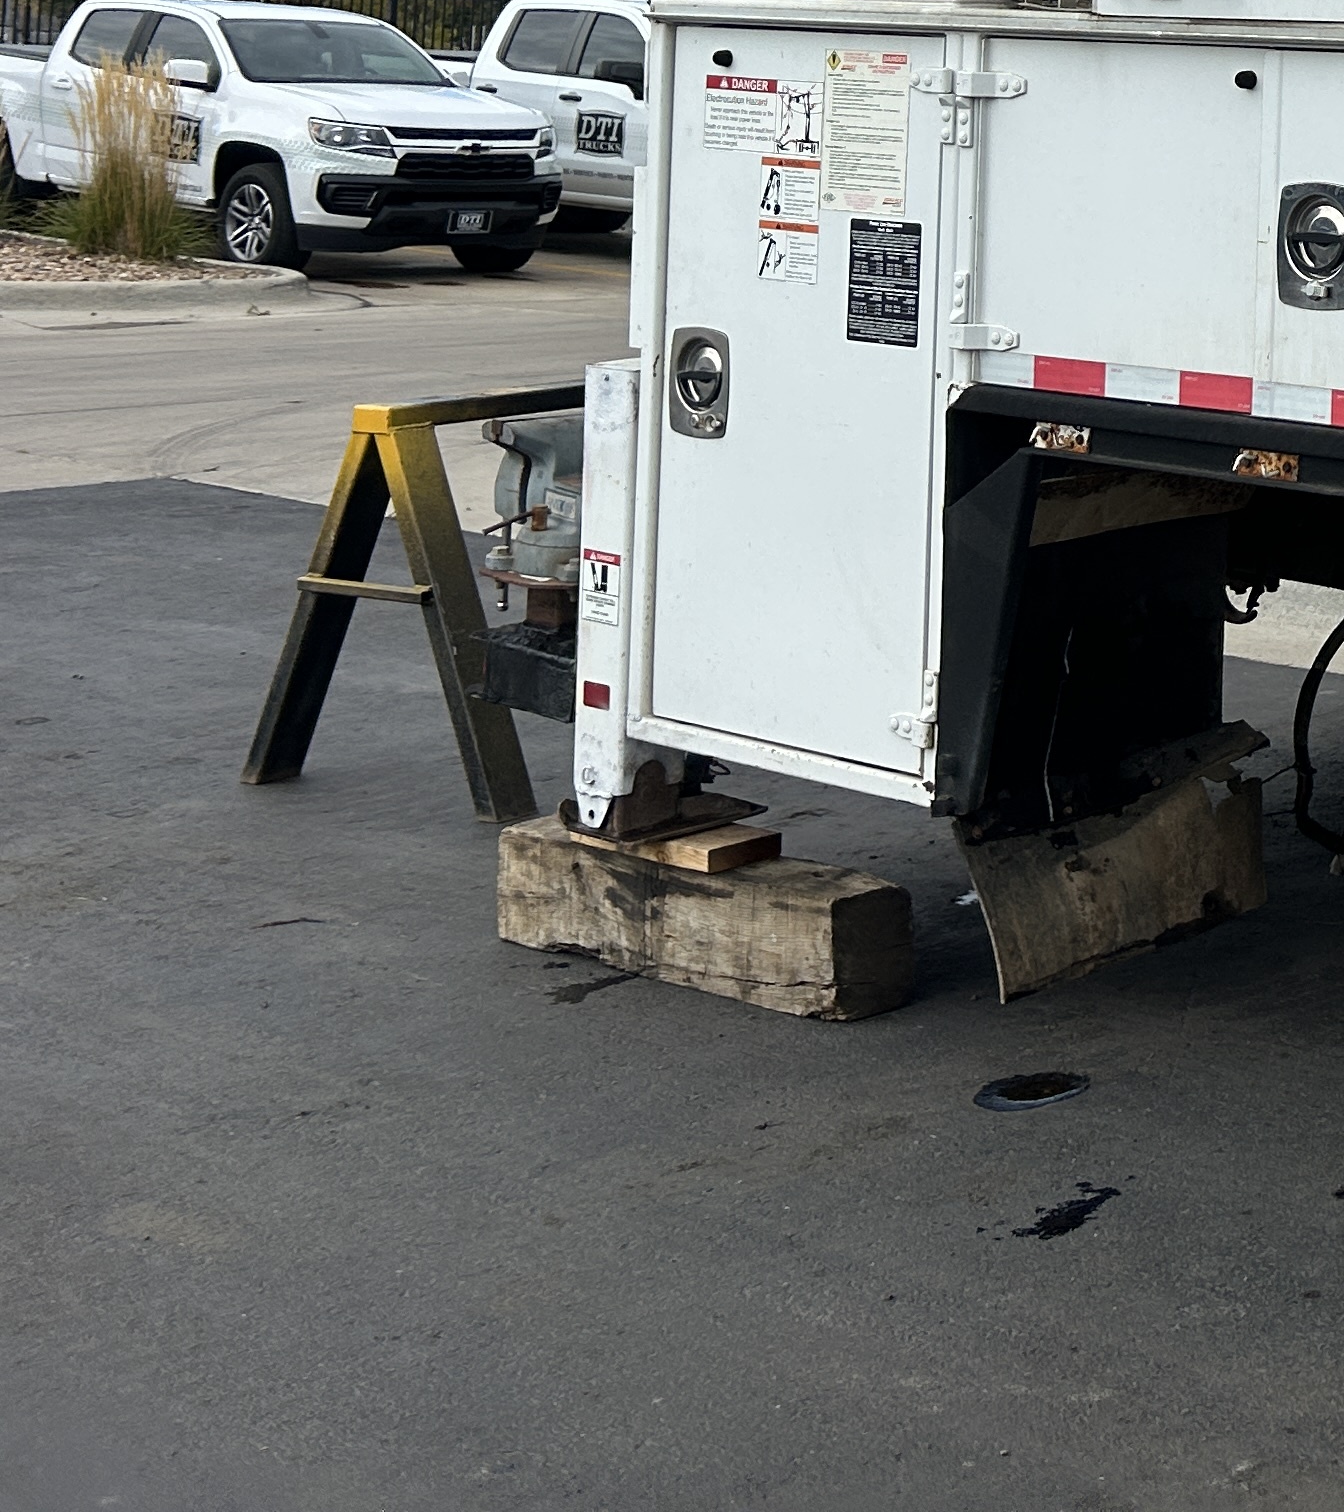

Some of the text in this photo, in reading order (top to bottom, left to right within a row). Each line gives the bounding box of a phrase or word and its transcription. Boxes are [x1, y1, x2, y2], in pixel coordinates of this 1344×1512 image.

[731, 78, 769, 91] DANGER
[578, 115, 622, 141] DTI
[578, 139, 622, 152] TRUCKS
[461, 214, 481, 224] DTI
